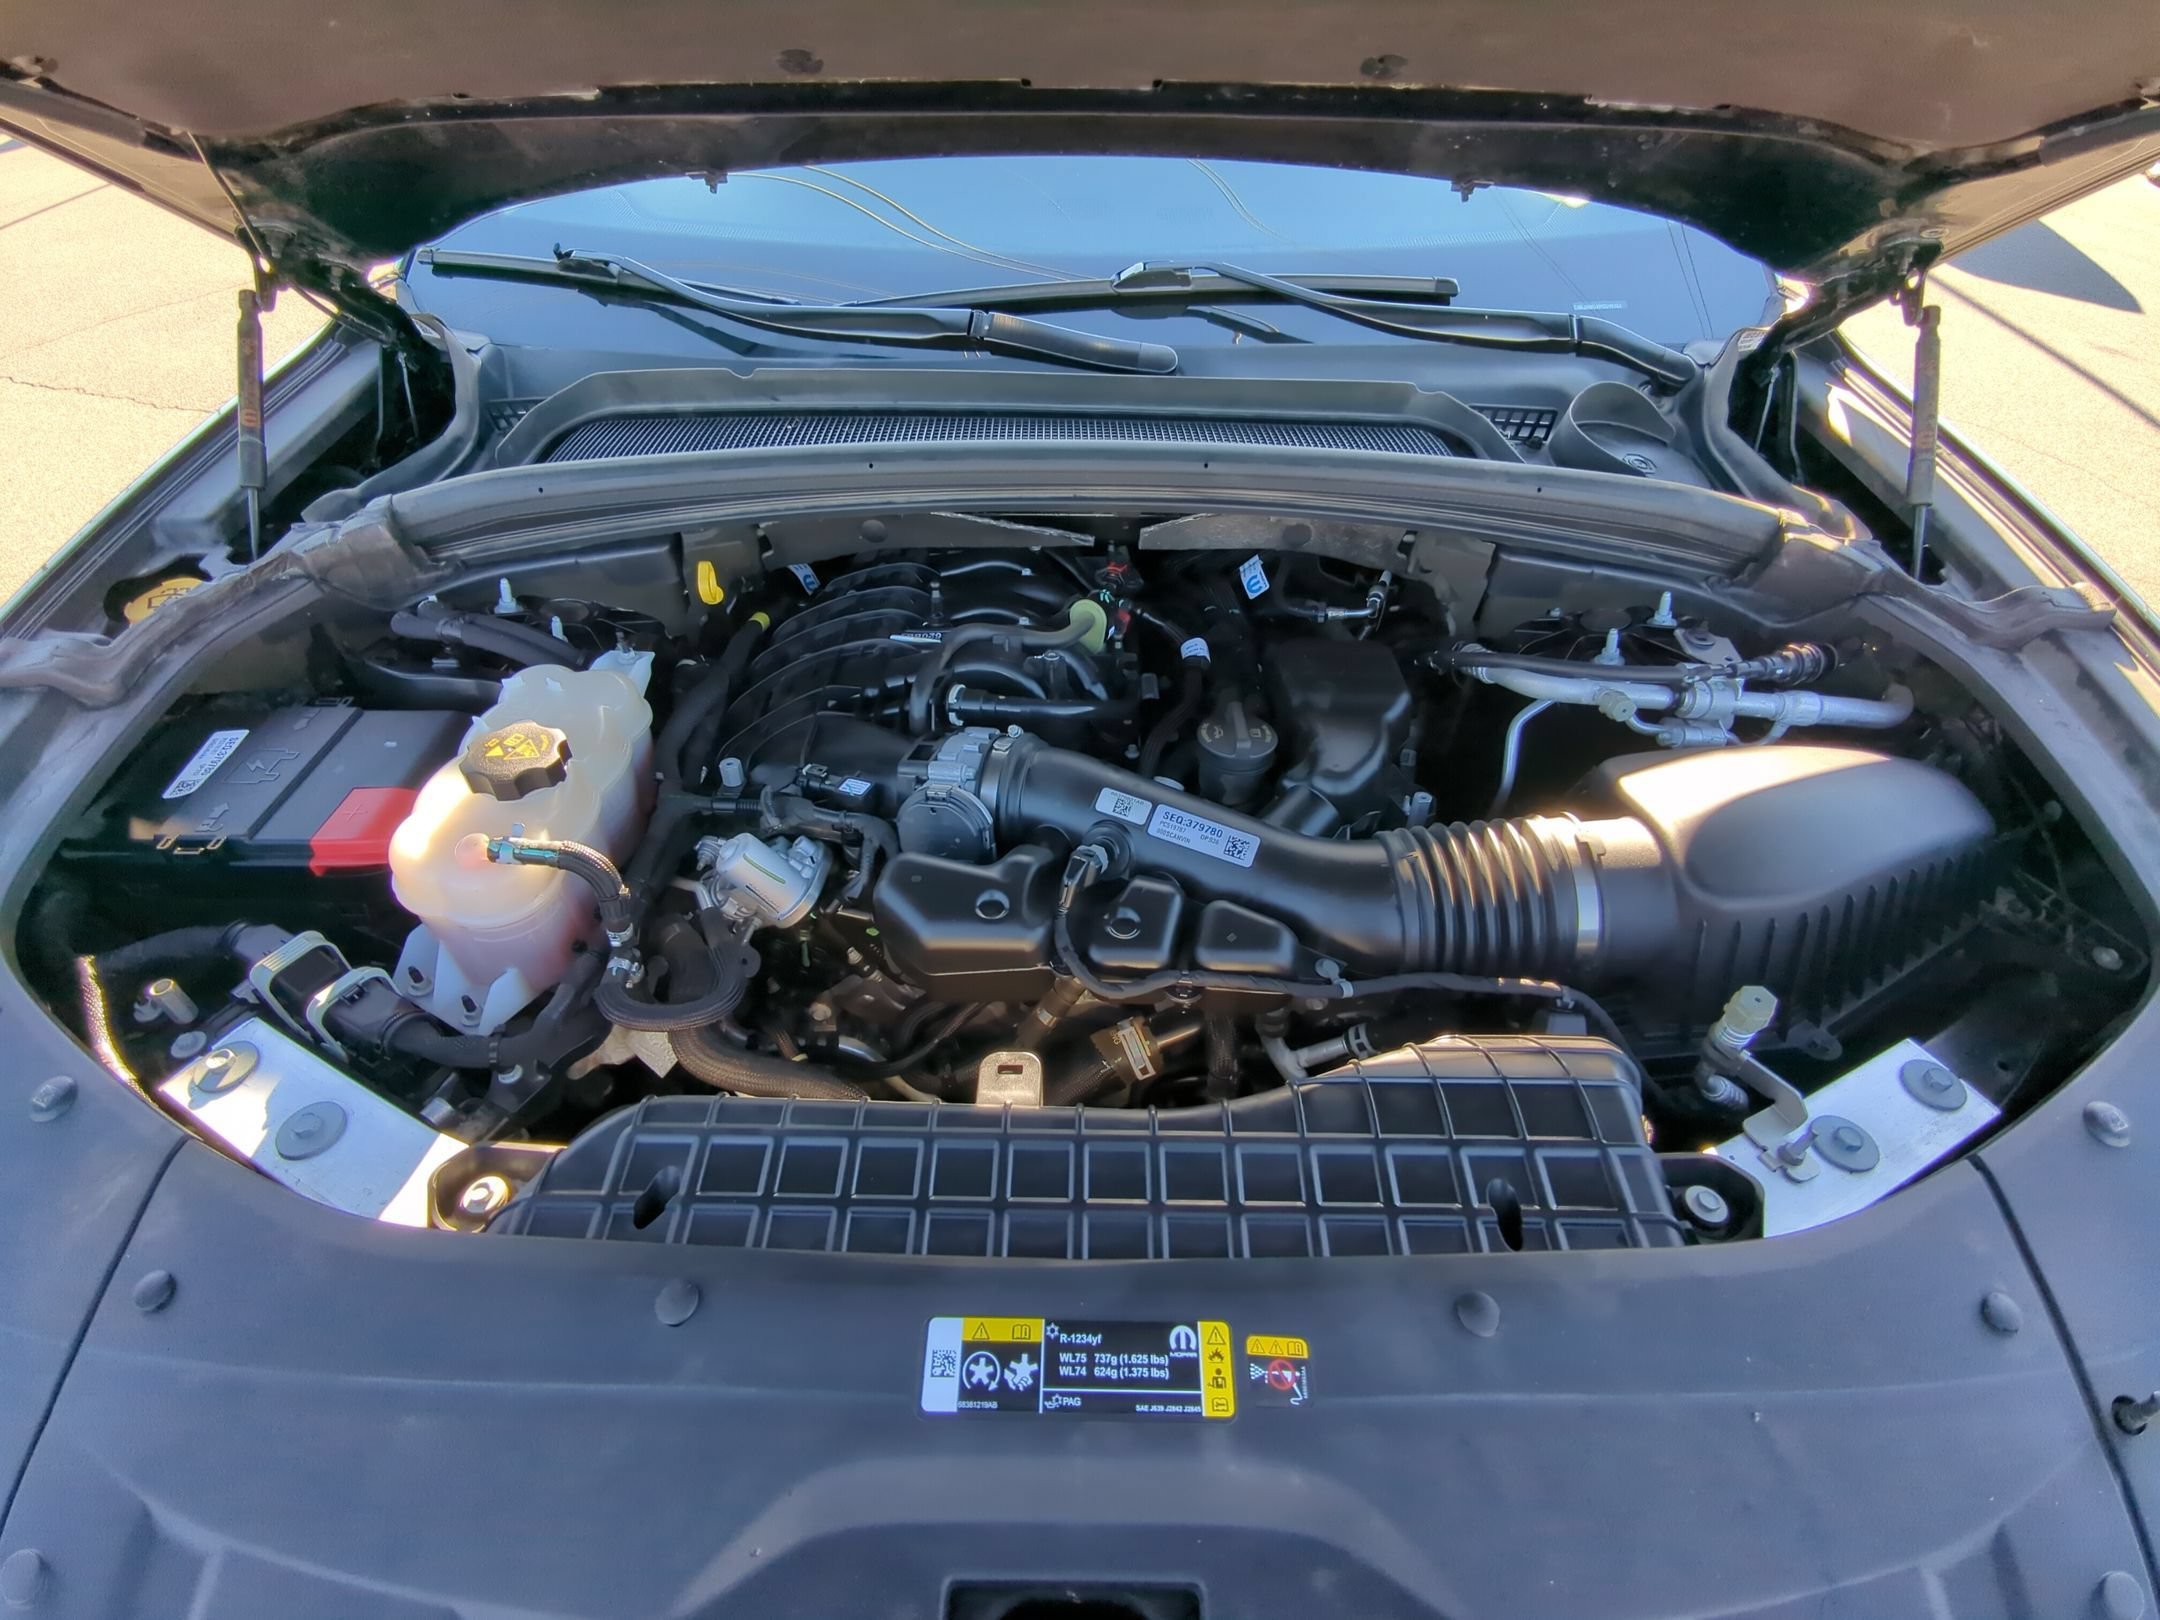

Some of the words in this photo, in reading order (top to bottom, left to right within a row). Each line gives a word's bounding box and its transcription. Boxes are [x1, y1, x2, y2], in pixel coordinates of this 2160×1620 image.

[1162, 811, 1224, 838] SEQ:379780
[1059, 1333, 1102, 1346] R-1234yf
[1059, 1352, 1087, 1363] WL75
[1094, 1353, 1118, 1366] 737g
[1119, 1353, 1149, 1366] (1.625
[1150, 1354, 1169, 1366] lbs)
[1059, 1366, 1087, 1376] WL74
[1094, 1367, 1118, 1379] 624g
[1119, 1368, 1149, 1380] (1.375
[1150, 1368, 1170, 1380] lbs)
[1062, 1397, 1081, 1407] PAG
